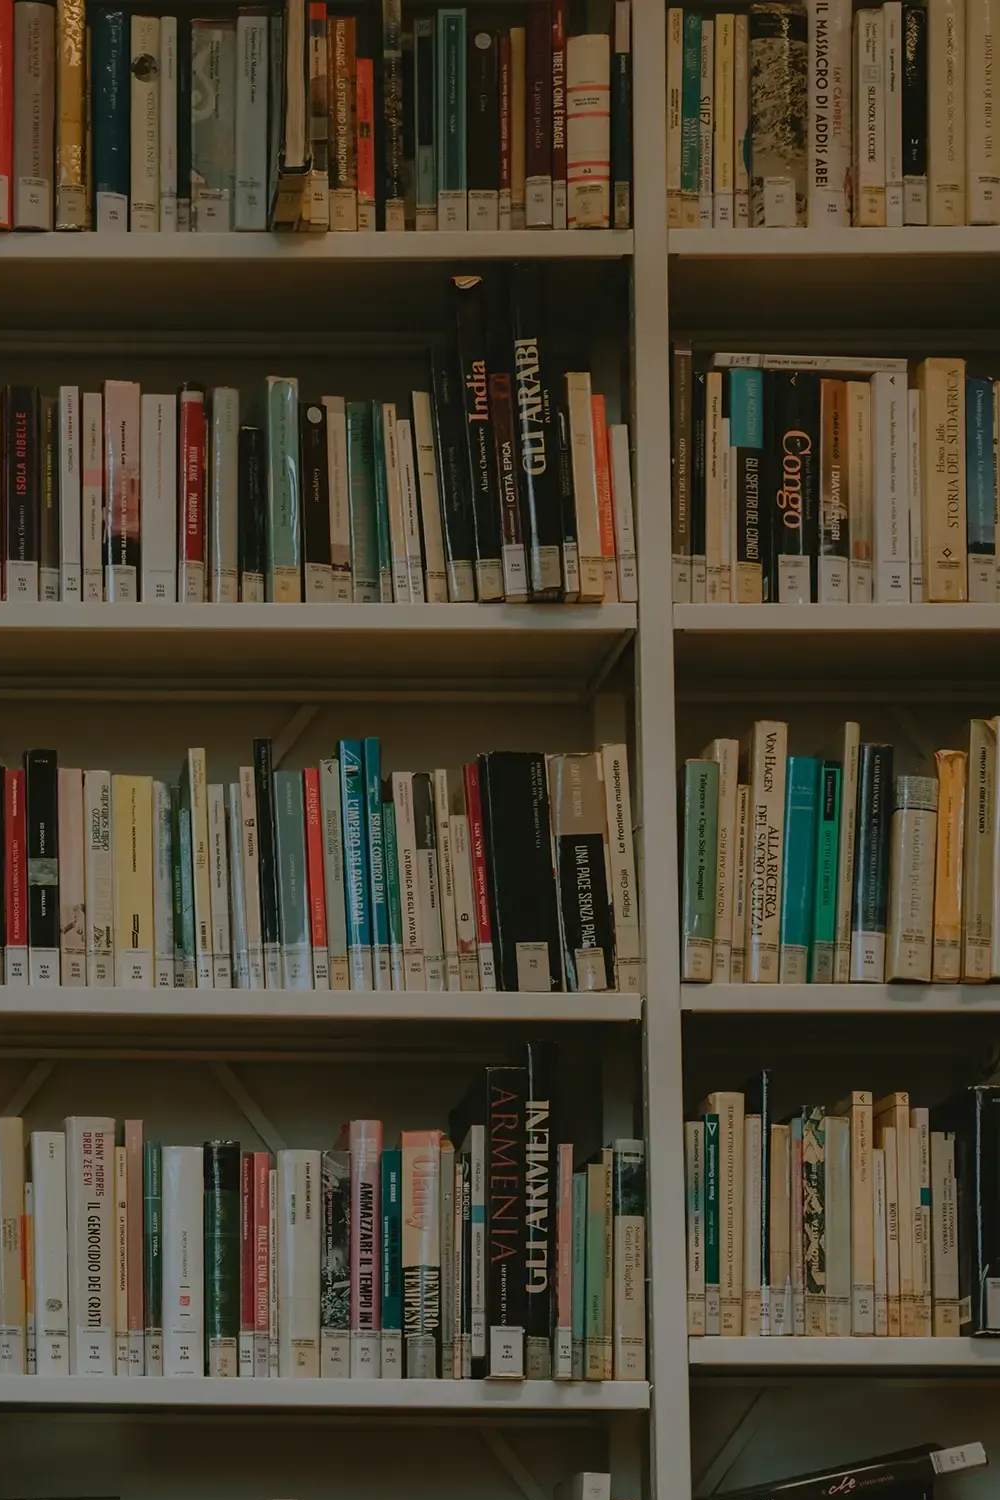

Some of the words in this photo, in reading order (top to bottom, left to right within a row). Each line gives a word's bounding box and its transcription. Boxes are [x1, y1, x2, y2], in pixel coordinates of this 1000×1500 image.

[816, 2, 827, 13] IL
[552, 51, 563, 74] TIBET,
[816, 20, 828, 90] MASSACRO
[553, 76, 563, 86] LA
[553, 88, 563, 108] CINA
[699, 96, 711, 125] SUEZ
[816, 95, 828, 109] DI
[553, 116, 563, 149] FRAGILE
[816, 114, 828, 154] ADDIS
[465, 360, 488, 423] India
[514, 337, 539, 424] ARABI
[947, 370, 959, 445] SUDAFRICA
[16, 412, 26, 457] RIBELLE
[520, 430, 547, 477] GLI
[746, 458, 758, 472] GLI
[948, 451, 959, 475] DEL
[16, 464, 26, 495] ISOLA
[746, 474, 758, 508] SPETTRI
[776, 430, 812, 528] Congo
[746, 510, 759, 525] DEL
[948, 479, 959, 529] STORIA
[746, 528, 759, 559] CONGO
[699, 773, 708, 809] Talayesva
[371, 813, 382, 844] ISRAELE
[697, 818, 706, 838] Capo
[755, 805, 767, 829] DEL
[574, 845, 588, 865] UNA
[698, 840, 706, 856] Sole
[753, 833, 766, 874] SACRO
[768, 826, 779, 861] ALLA
[371, 846, 382, 880] CONTRO
[403, 849, 414, 889] L'ATOMICA
[576, 867, 590, 890] PACE
[372, 883, 384, 904] IRAN
[697, 865, 706, 900] Bompiani
[765, 864, 778, 919] RICERCA
[406, 892, 416, 914] DEGLI
[578, 893, 594, 921] SENZA
[83, 1132, 92, 1156] DROR
[95, 1132, 104, 1160] BENNY
[83, 1159, 93, 1186] ZE'EVI
[95, 1165, 104, 1197] MORRIS
[491, 1085, 519, 1265] ARMENIA
[524, 1099, 550, 1232] ARMENI
[87, 1202, 100, 1211] IL
[360, 1182, 372, 1254] AMMAZZARE
[87, 1215, 101, 1272] GENOCIDIO
[257, 1225, 267, 1252] MILLE
[625, 1226, 634, 1250] Gente
[258, 1264, 267, 1282] UNA
[360, 1258, 372, 1269] IL
[524, 1240, 549, 1293] GLI
[88, 1276, 101, 1292] DEI
[360, 1272, 372, 1305] TEMPO
[624, 1264, 634, 1300] Baghdad
[257, 1287, 268, 1326] TURCHIA
[404, 1270, 421, 1338] TEMPESTA
[423, 1270, 440, 1328] DENTRO
[361, 1308, 373, 1323] IN
